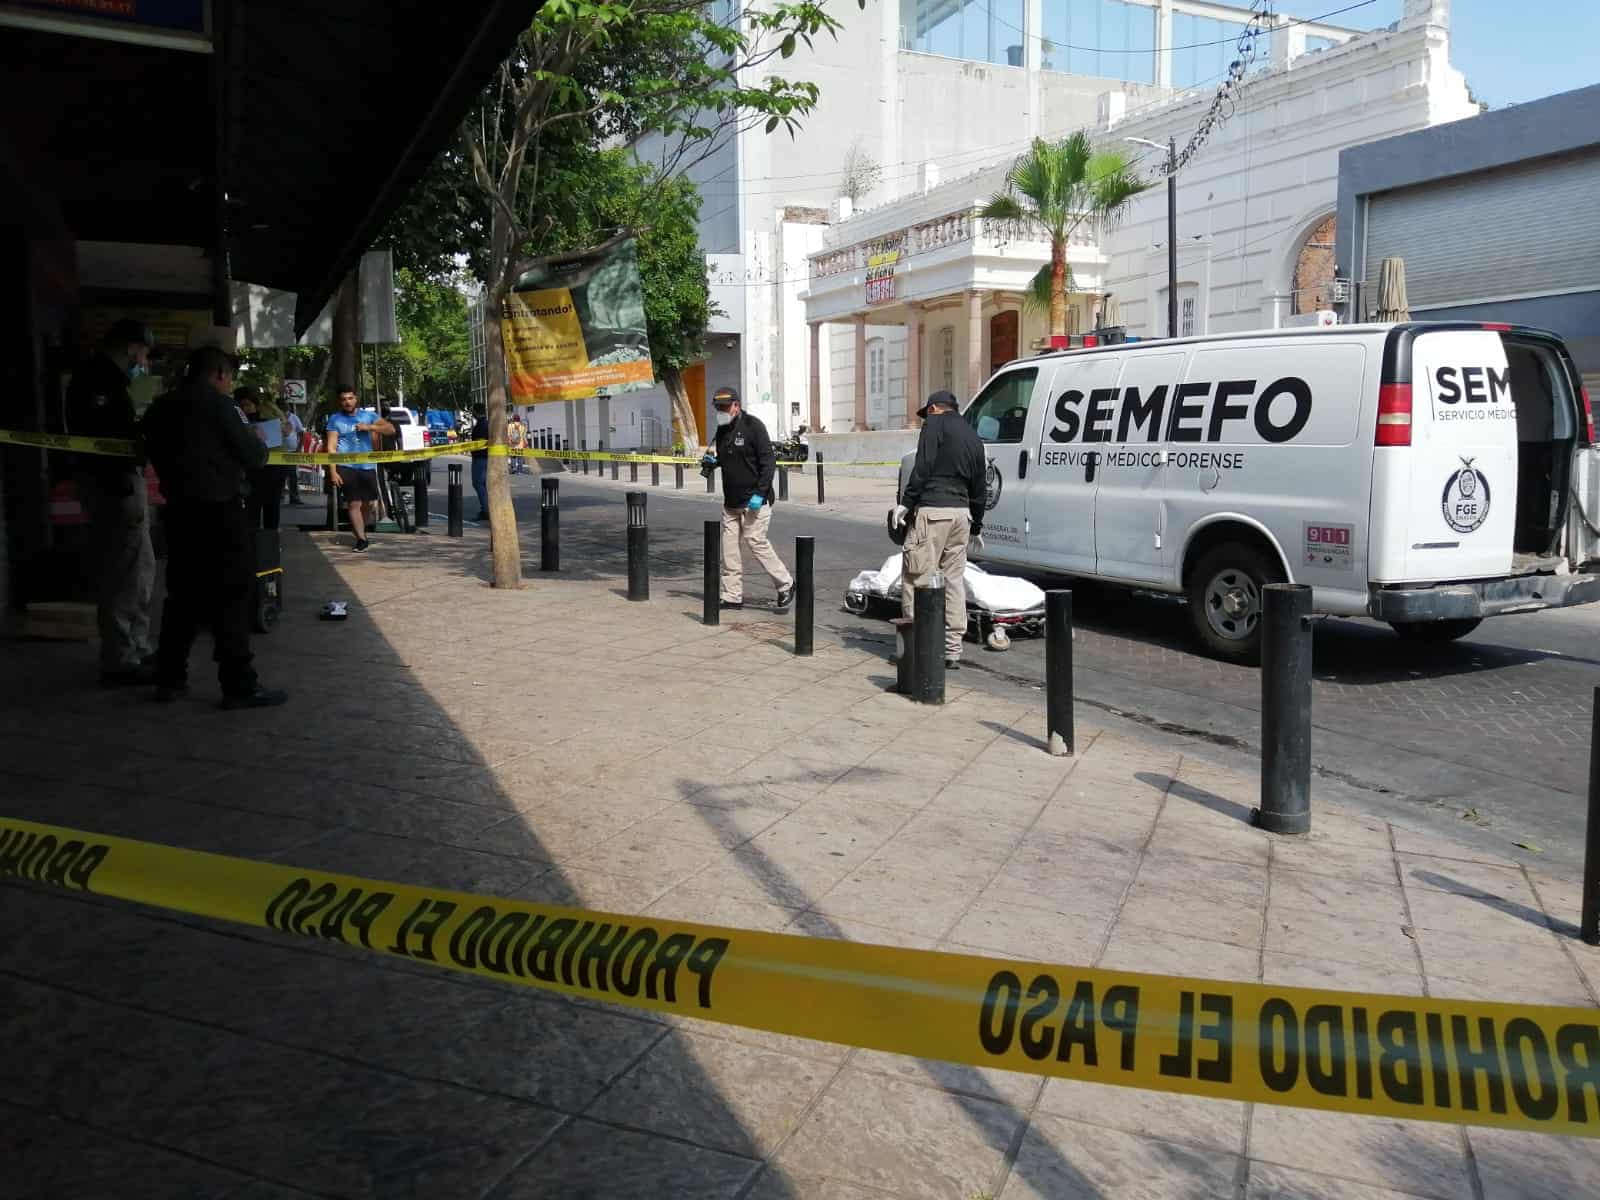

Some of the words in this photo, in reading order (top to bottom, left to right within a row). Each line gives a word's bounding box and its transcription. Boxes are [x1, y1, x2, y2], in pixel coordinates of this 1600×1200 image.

[1435, 366, 1513, 405] SEM
[1049, 376, 1313, 444] SEMEFO
[1438, 409, 1486, 421] SERVICIO
[1045, 451, 1103, 466] SERVICO
[1106, 445, 1162, 468] MÉDICO
[1167, 452, 1245, 469] FORENSE
[1456, 503, 1478, 515] FGE
[1310, 528, 1345, 543] 911
